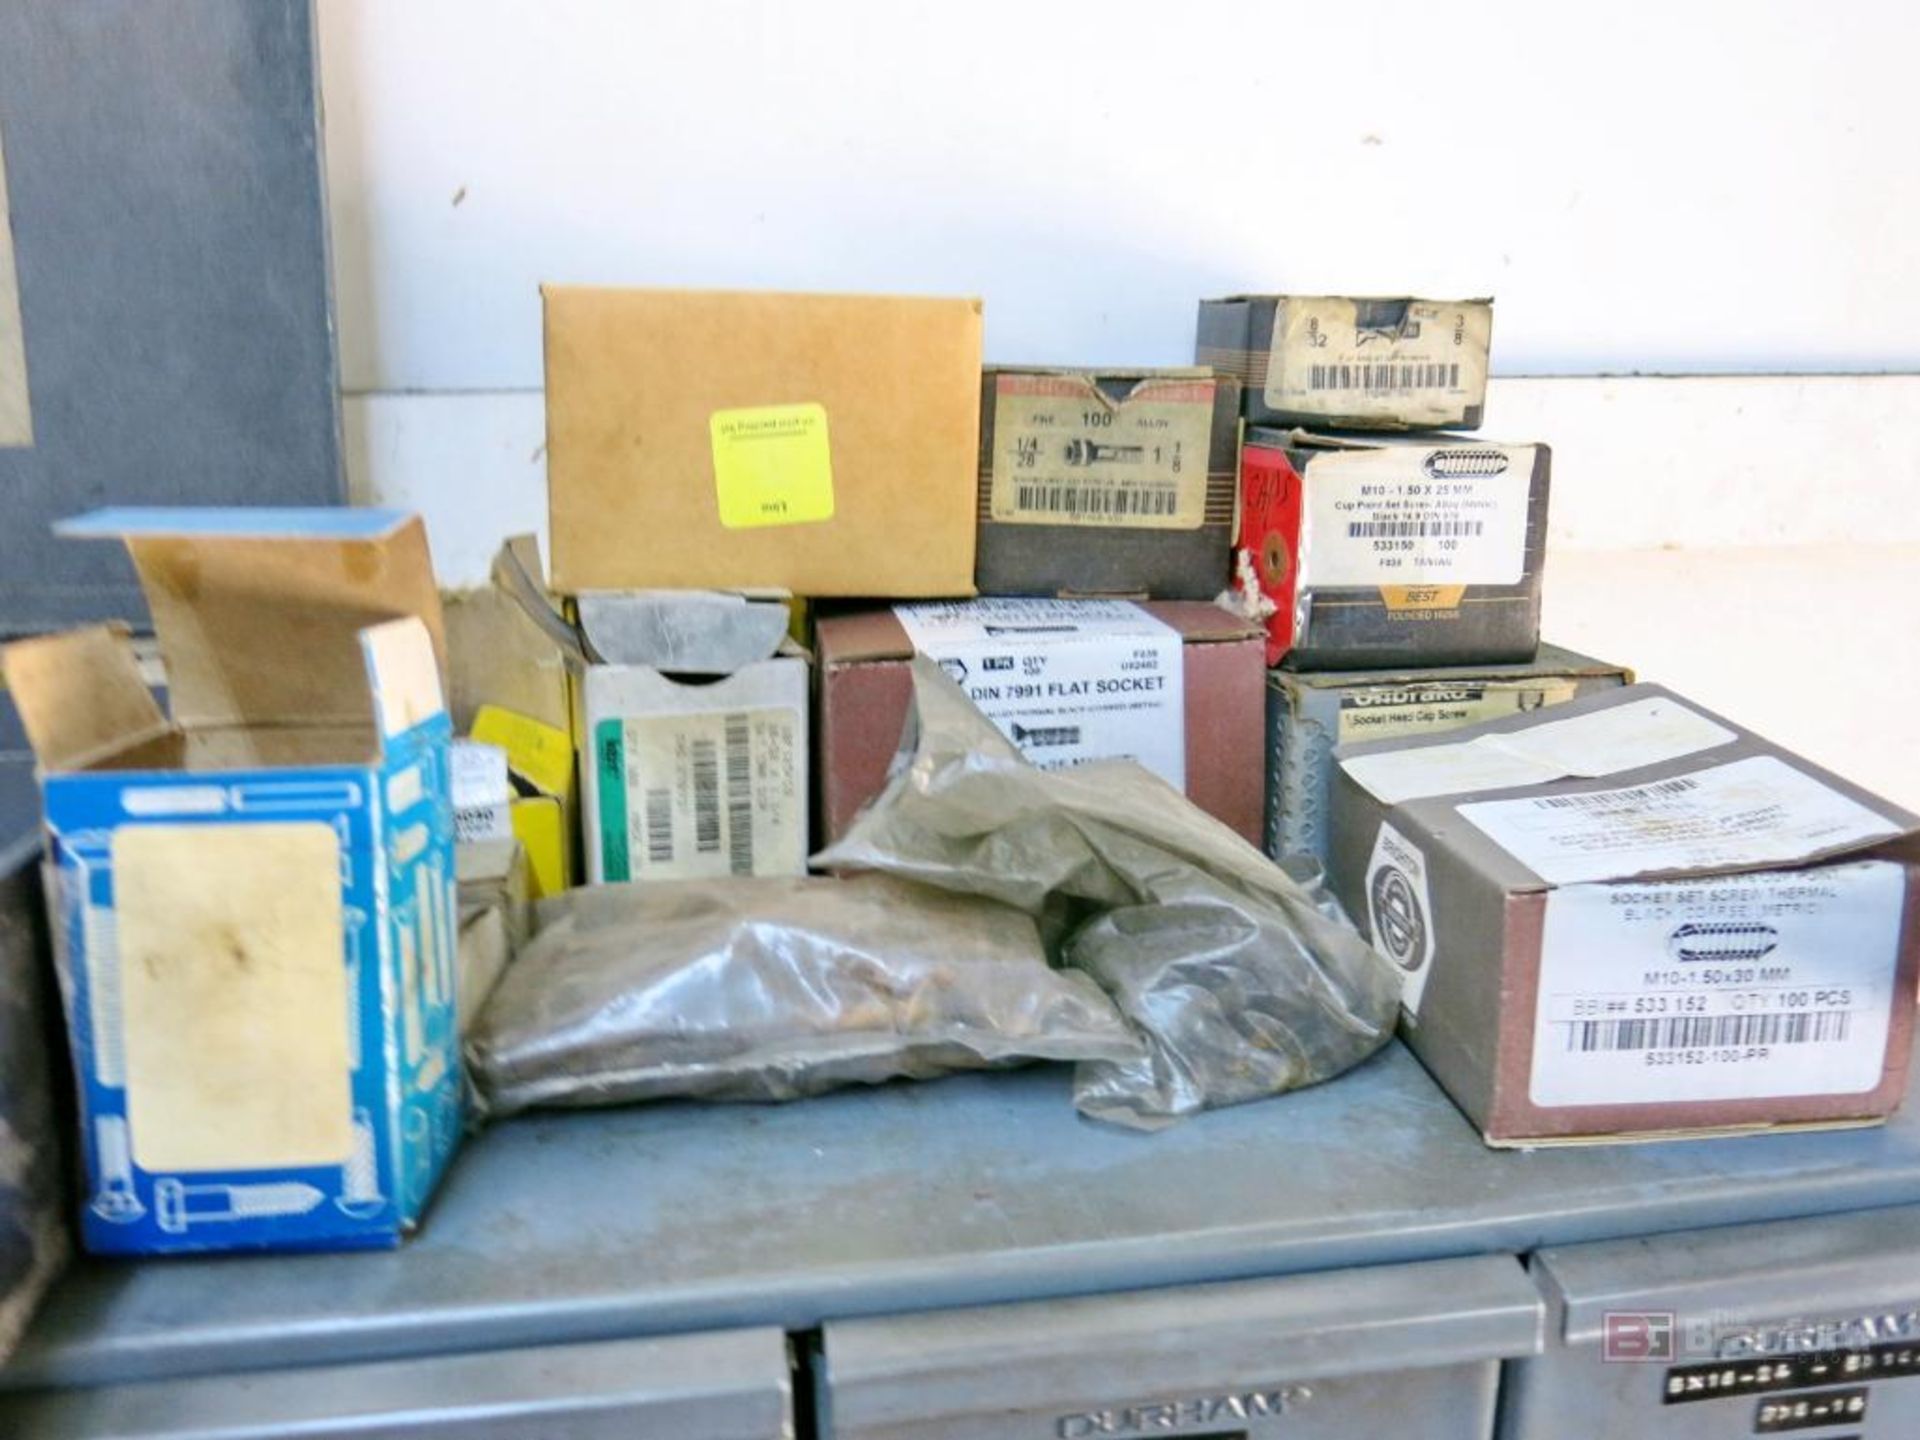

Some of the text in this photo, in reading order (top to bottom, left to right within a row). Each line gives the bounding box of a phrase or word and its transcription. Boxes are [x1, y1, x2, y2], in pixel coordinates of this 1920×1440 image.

[1081, 412, 1113, 428] 100
[1361, 485, 1385, 496] M10
[1397, 485, 1421, 496] 1.50
[1436, 485, 1449, 495] 25
[1334, 501, 1356, 512] Cup
[1372, 540, 1458, 551] 533150 100
[1405, 591, 1439, 603] BEST
[971, 676, 1166, 701] DIN 7991 FLAT SOCKET
[1353, 708, 1468, 726] Socket Head Cap Screw
[1610, 885, 1837, 905] SOCKET SET SCREW THERMAL
[1760, 967, 1791, 983] MM
[1634, 997, 1667, 1013] 533
[1675, 996, 1707, 1012] 152
[1779, 991, 1808, 1008] 100
[1814, 990, 1851, 1006] PCS
[1645, 1048, 1770, 1066] 533152-100-PR
